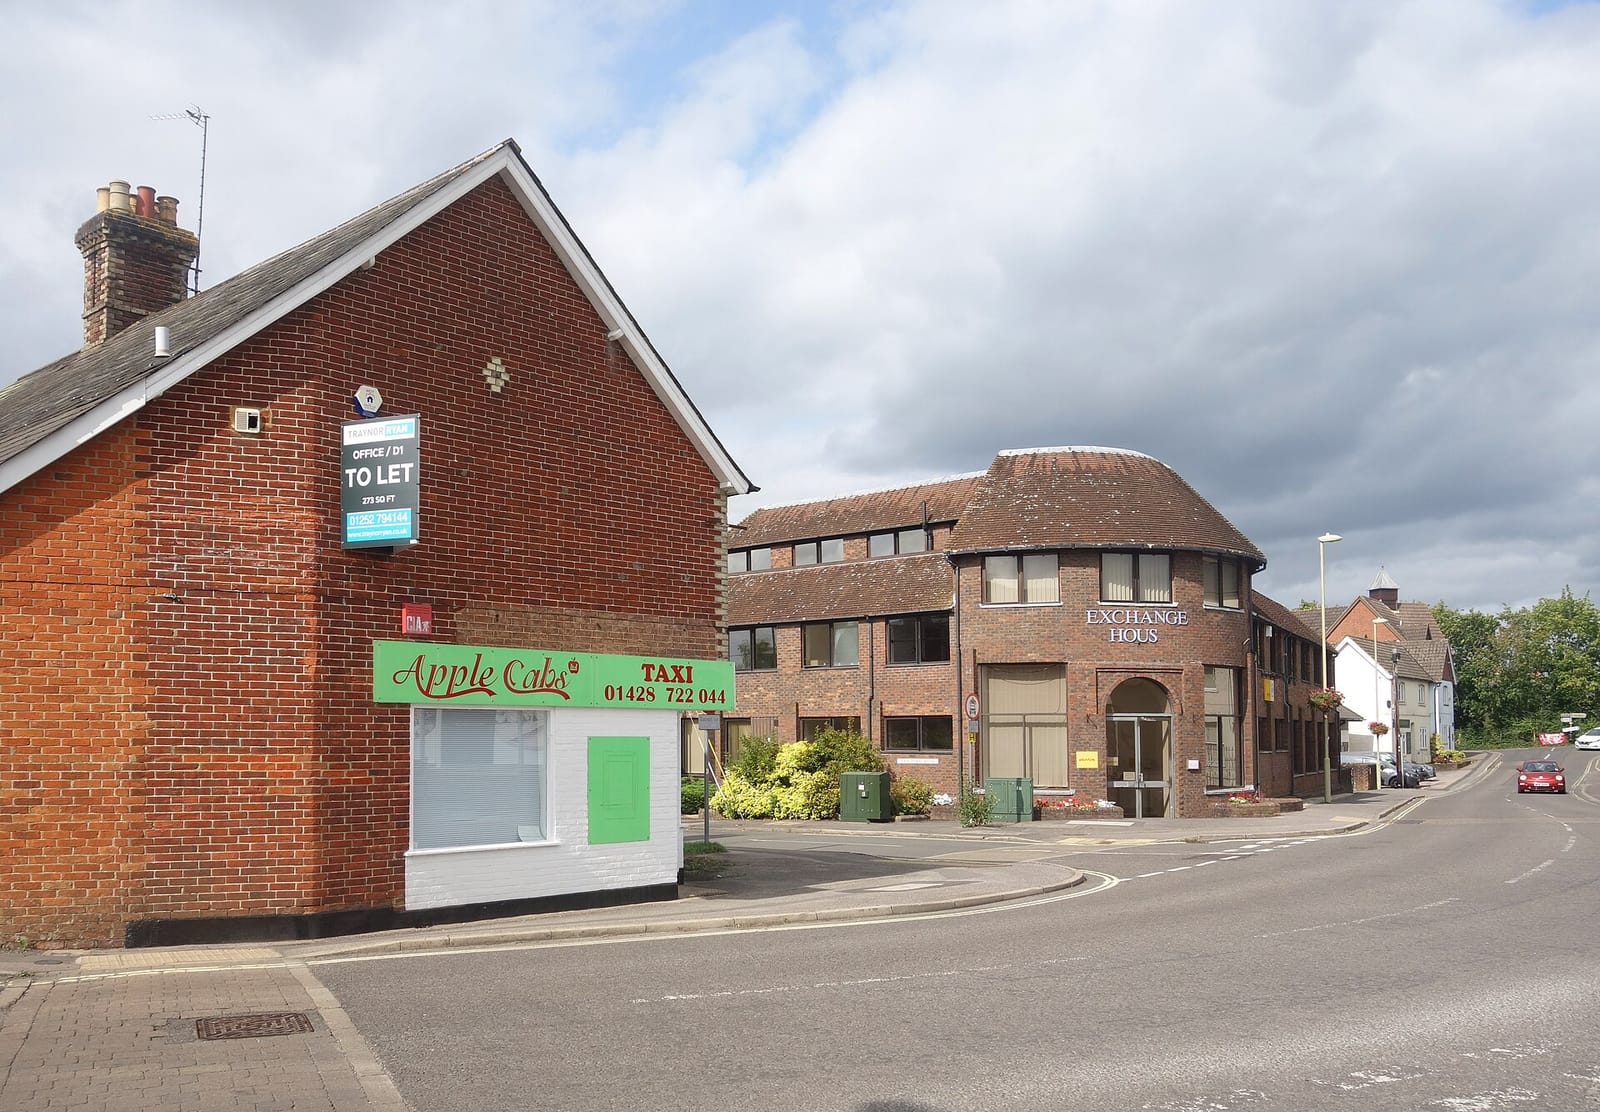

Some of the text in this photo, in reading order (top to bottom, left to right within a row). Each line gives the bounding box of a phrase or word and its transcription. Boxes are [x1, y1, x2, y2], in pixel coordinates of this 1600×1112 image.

[348, 423, 408, 439] TRAYNOR RYAN
[353, 445, 404, 460] OFFICE / D1
[345, 463, 414, 488] TO LET
[362, 494, 396, 505] 273 SQ FT
[349, 511, 408, 526] 01252 794144
[1086, 609, 1188, 625] EXCHANGE
[1109, 628, 1159, 643] HOUS
[392, 653, 571, 700] Apple Cabs
[641, 663, 693, 683] TAXI
[604, 685, 726, 704] 01428 722 044
